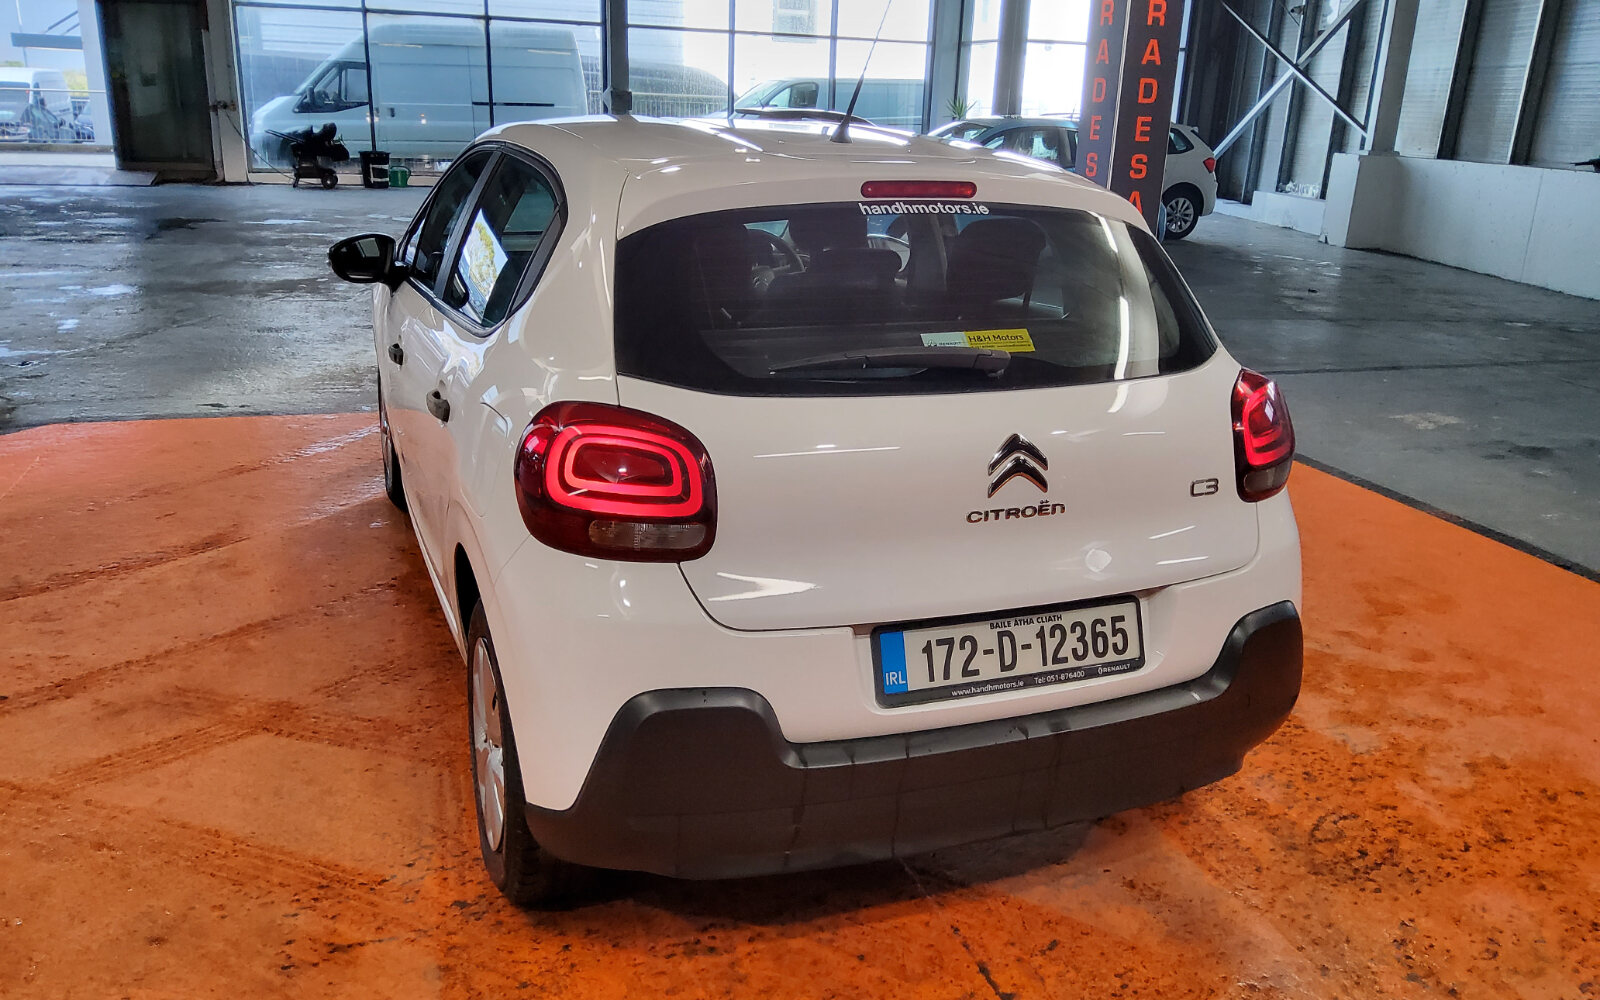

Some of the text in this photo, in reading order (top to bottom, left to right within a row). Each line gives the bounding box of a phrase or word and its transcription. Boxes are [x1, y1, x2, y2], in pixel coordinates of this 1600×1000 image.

[858, 202, 990, 216] handhmotors.ie
[968, 333, 1025, 343] H&H Motors
[1190, 478, 1219, 497] C3
[989, 620, 1012, 630] BAILE
[1036, 614, 1063, 624] CLIATH
[921, 615, 1129, 682] 172-D-12365
[885, 670, 906, 686] IRL
[951, 663, 1131, 697] www.handhmotors.ie Tel: 051-876400 RENAULT
